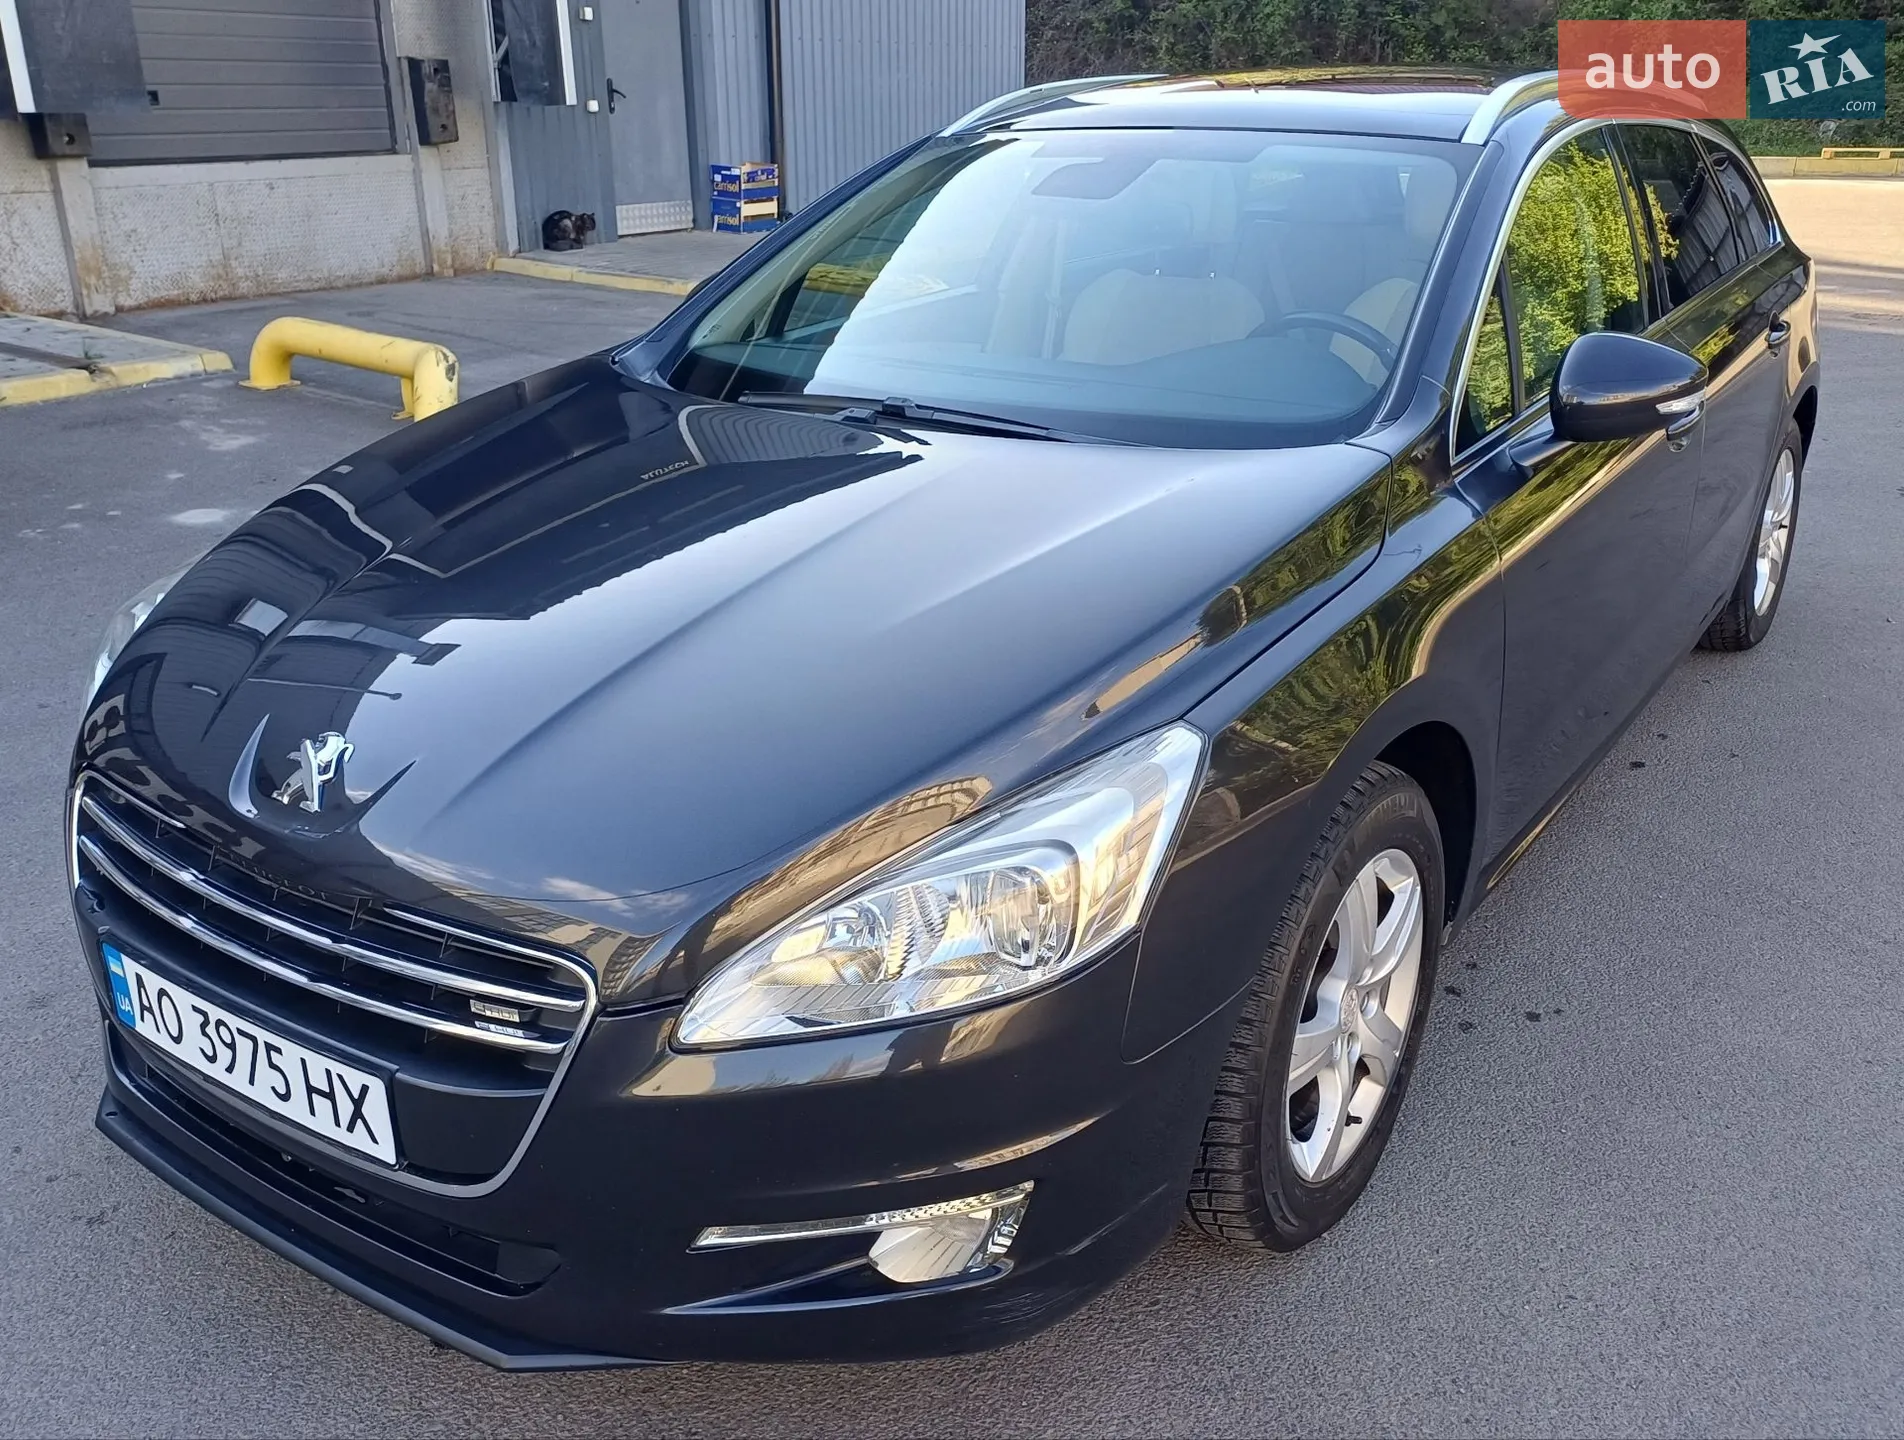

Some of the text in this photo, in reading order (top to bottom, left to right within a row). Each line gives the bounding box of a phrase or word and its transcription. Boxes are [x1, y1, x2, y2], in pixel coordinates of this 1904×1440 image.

[116, 991, 133, 1016] UA
[135, 971, 380, 1146] AO 3975 HX
